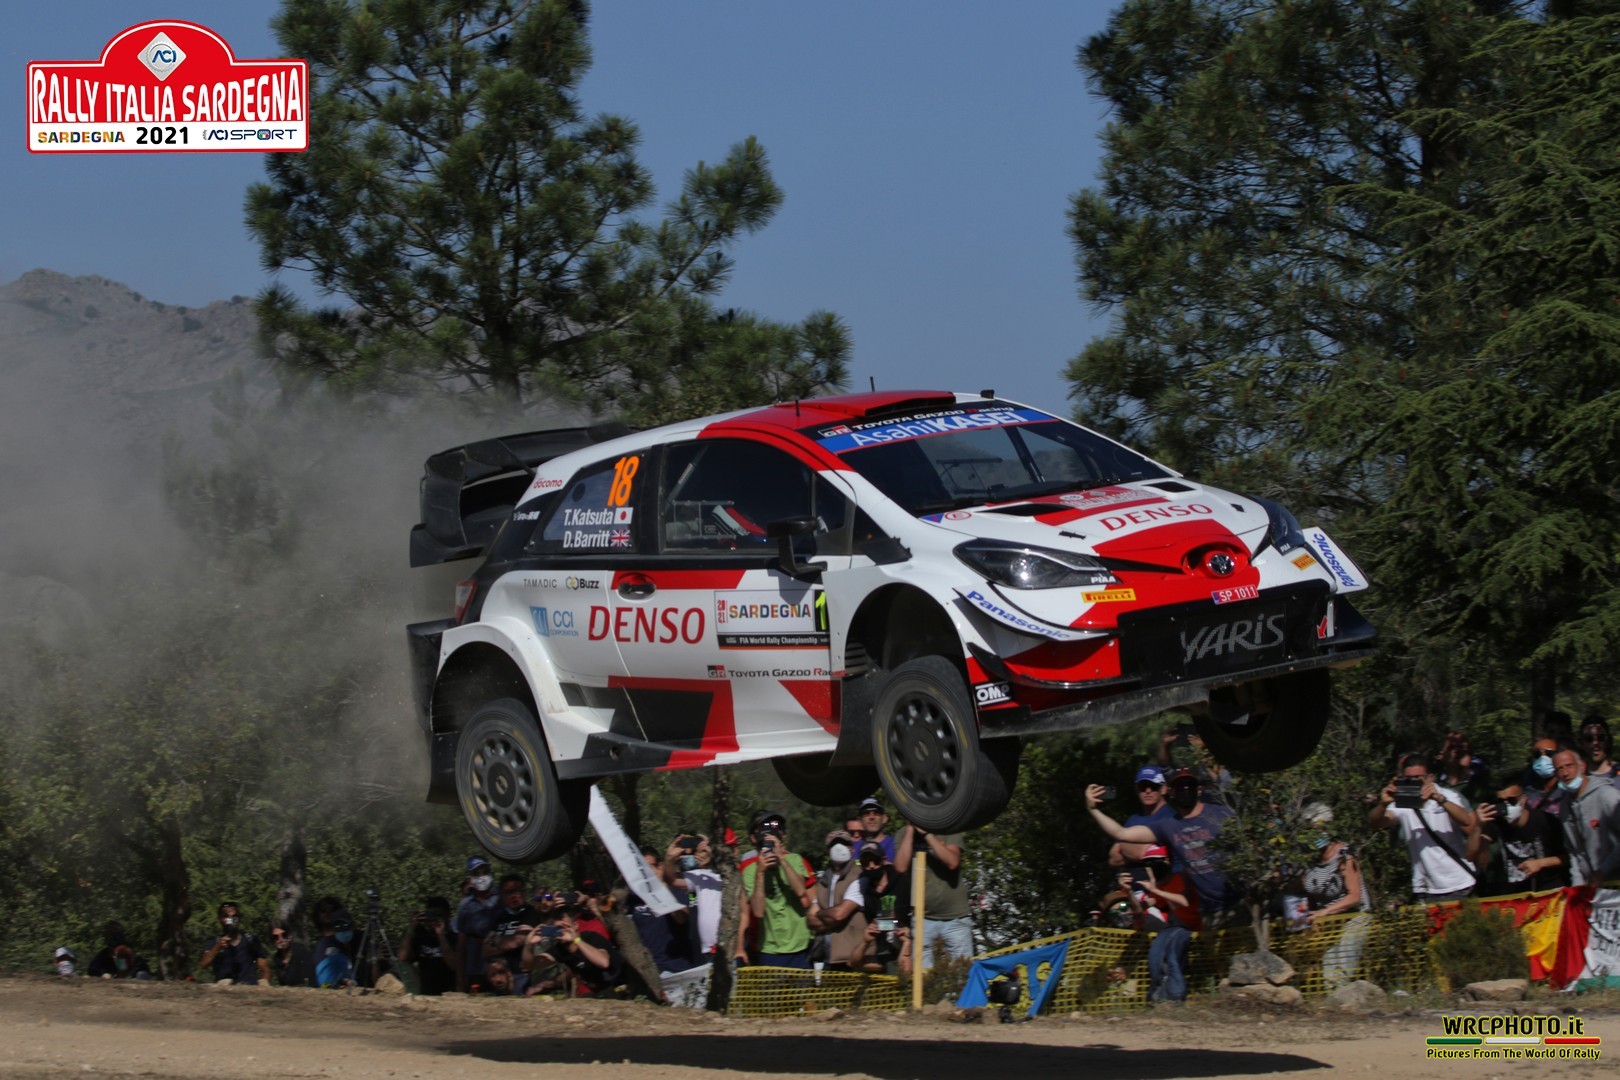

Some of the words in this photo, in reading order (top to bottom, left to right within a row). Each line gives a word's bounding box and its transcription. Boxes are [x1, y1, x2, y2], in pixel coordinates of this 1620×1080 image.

[850, 411, 1028, 447] AsahiKASEI
[852, 416, 913, 431] TOYOTA
[913, 409, 965, 420] GAZOO
[607, 455, 640, 507] 18
[564, 508, 614, 526] T.Katsuta
[1098, 503, 1214, 532] DENSO
[563, 530, 610, 548] D.Barritt
[1313, 533, 1360, 588] Panasonic
[580, 578, 600, 589] Buzz
[1091, 575, 1116, 584] PIAA
[1219, 590, 1233, 602] SP
[1235, 585, 1258, 599] 1011
[553, 610, 574, 628] CCI
[729, 604, 811, 619] SARDEGNA
[966, 590, 1071, 640] Panasonic
[588, 605, 706, 645] DENSO
[781, 636, 818, 645] Championship
[728, 670, 770, 678] TOYOTA
[772, 668, 811, 677] GAZOO
